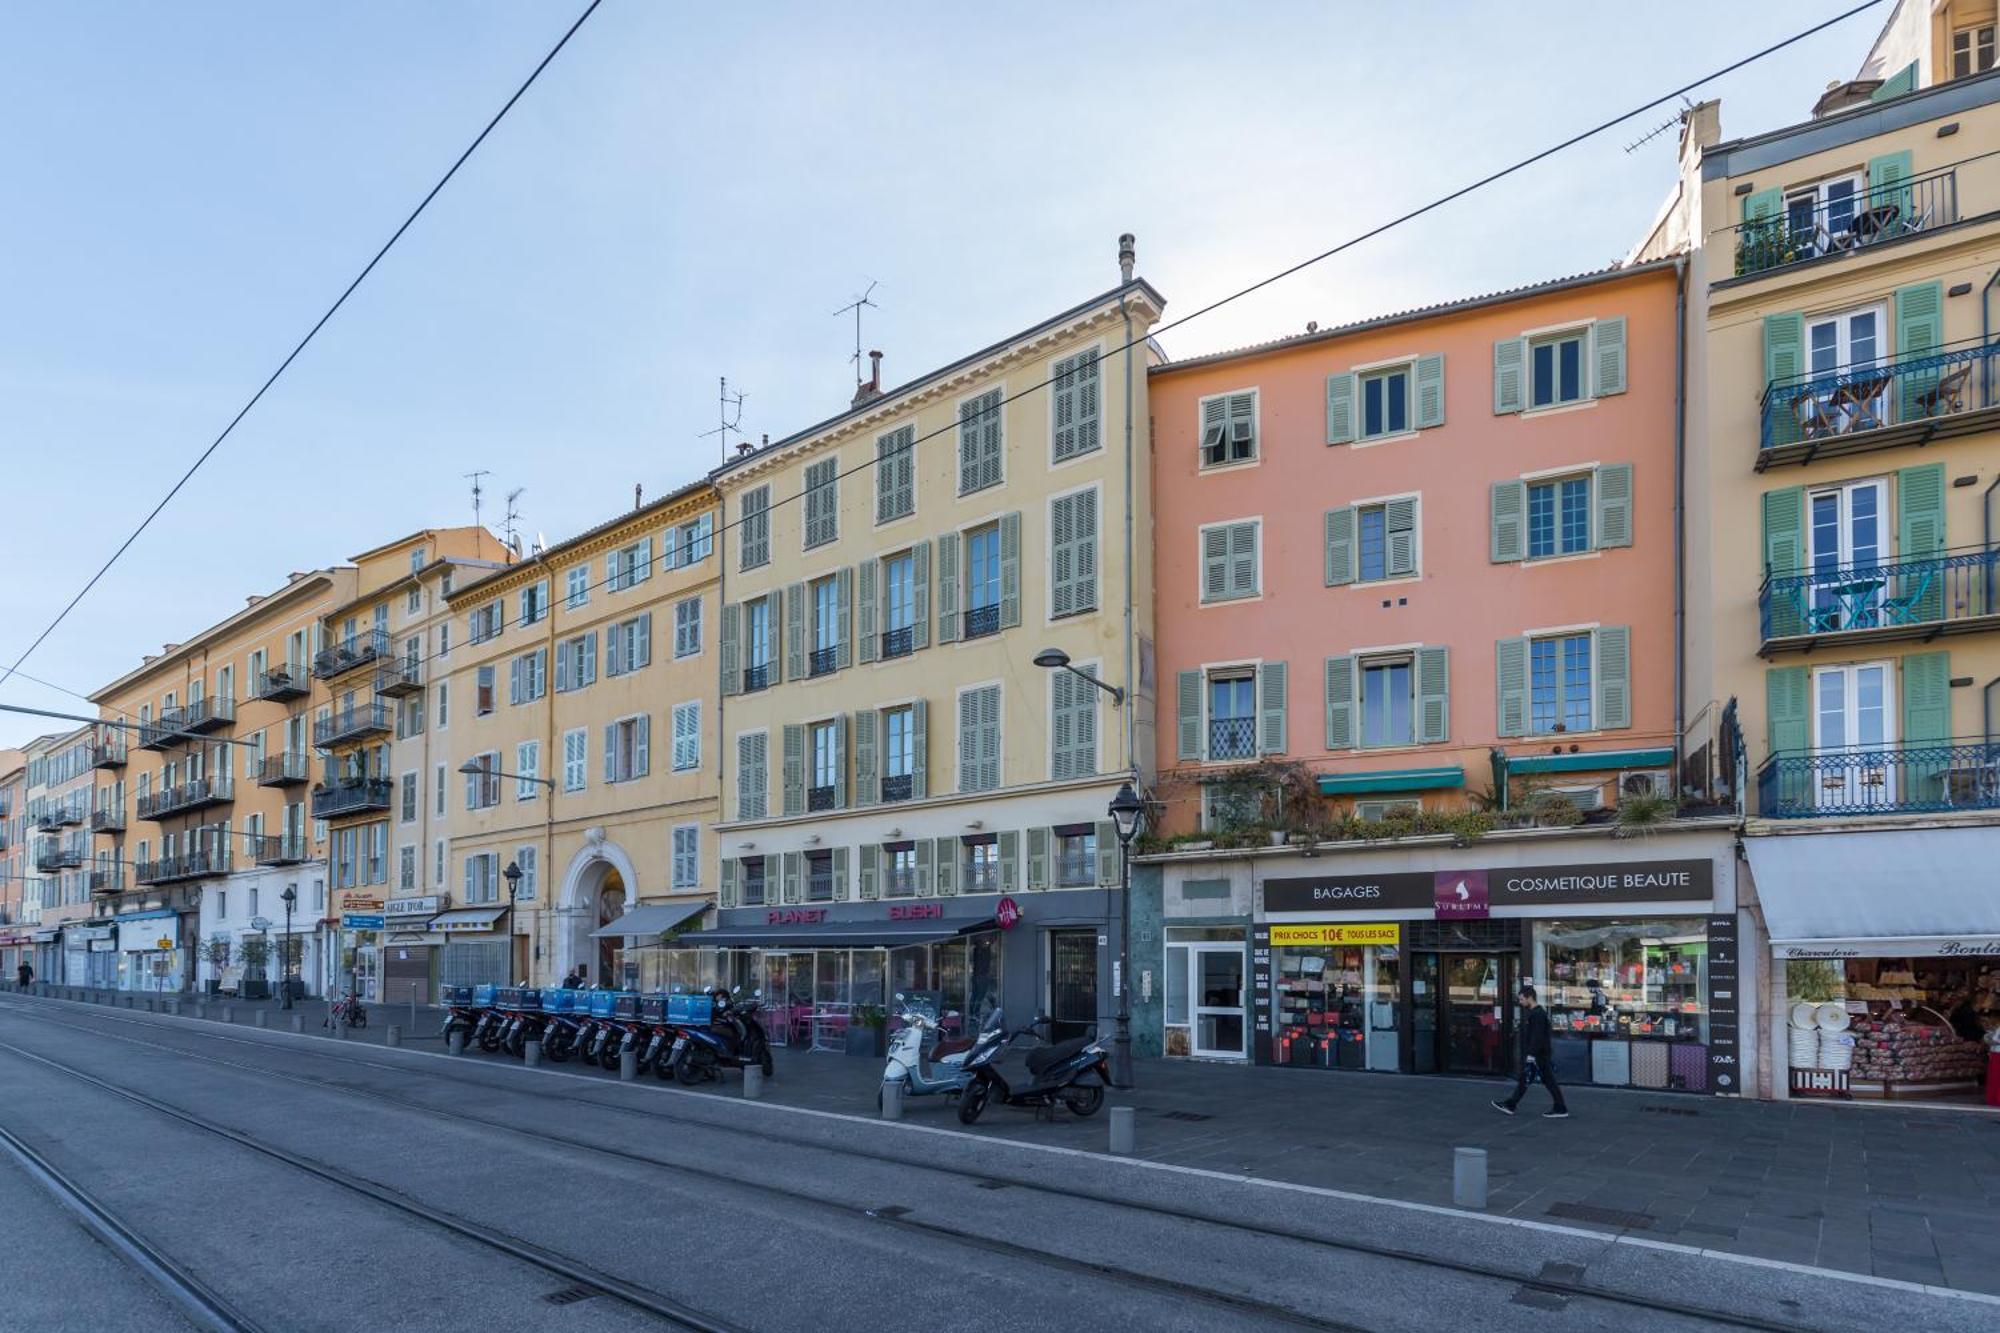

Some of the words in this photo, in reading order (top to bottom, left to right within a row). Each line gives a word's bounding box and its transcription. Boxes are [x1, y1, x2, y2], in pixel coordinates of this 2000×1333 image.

[1507, 875, 1617, 891] COSMETIQUE
[1623, 872, 1690, 887] BEAUTE
[1313, 885, 1380, 900] BAGAGES
[768, 907, 828, 925] PLANET
[889, 903, 943, 920] SUSHI
[1274, 931, 1291, 940] PRIX
[1292, 931, 1318, 939] CHOCS
[1321, 928, 1344, 941] 10€
[1347, 930, 1365, 938] TOUS
[1365, 930, 1378, 938] LES
[1378, 930, 1395, 938] SACS
